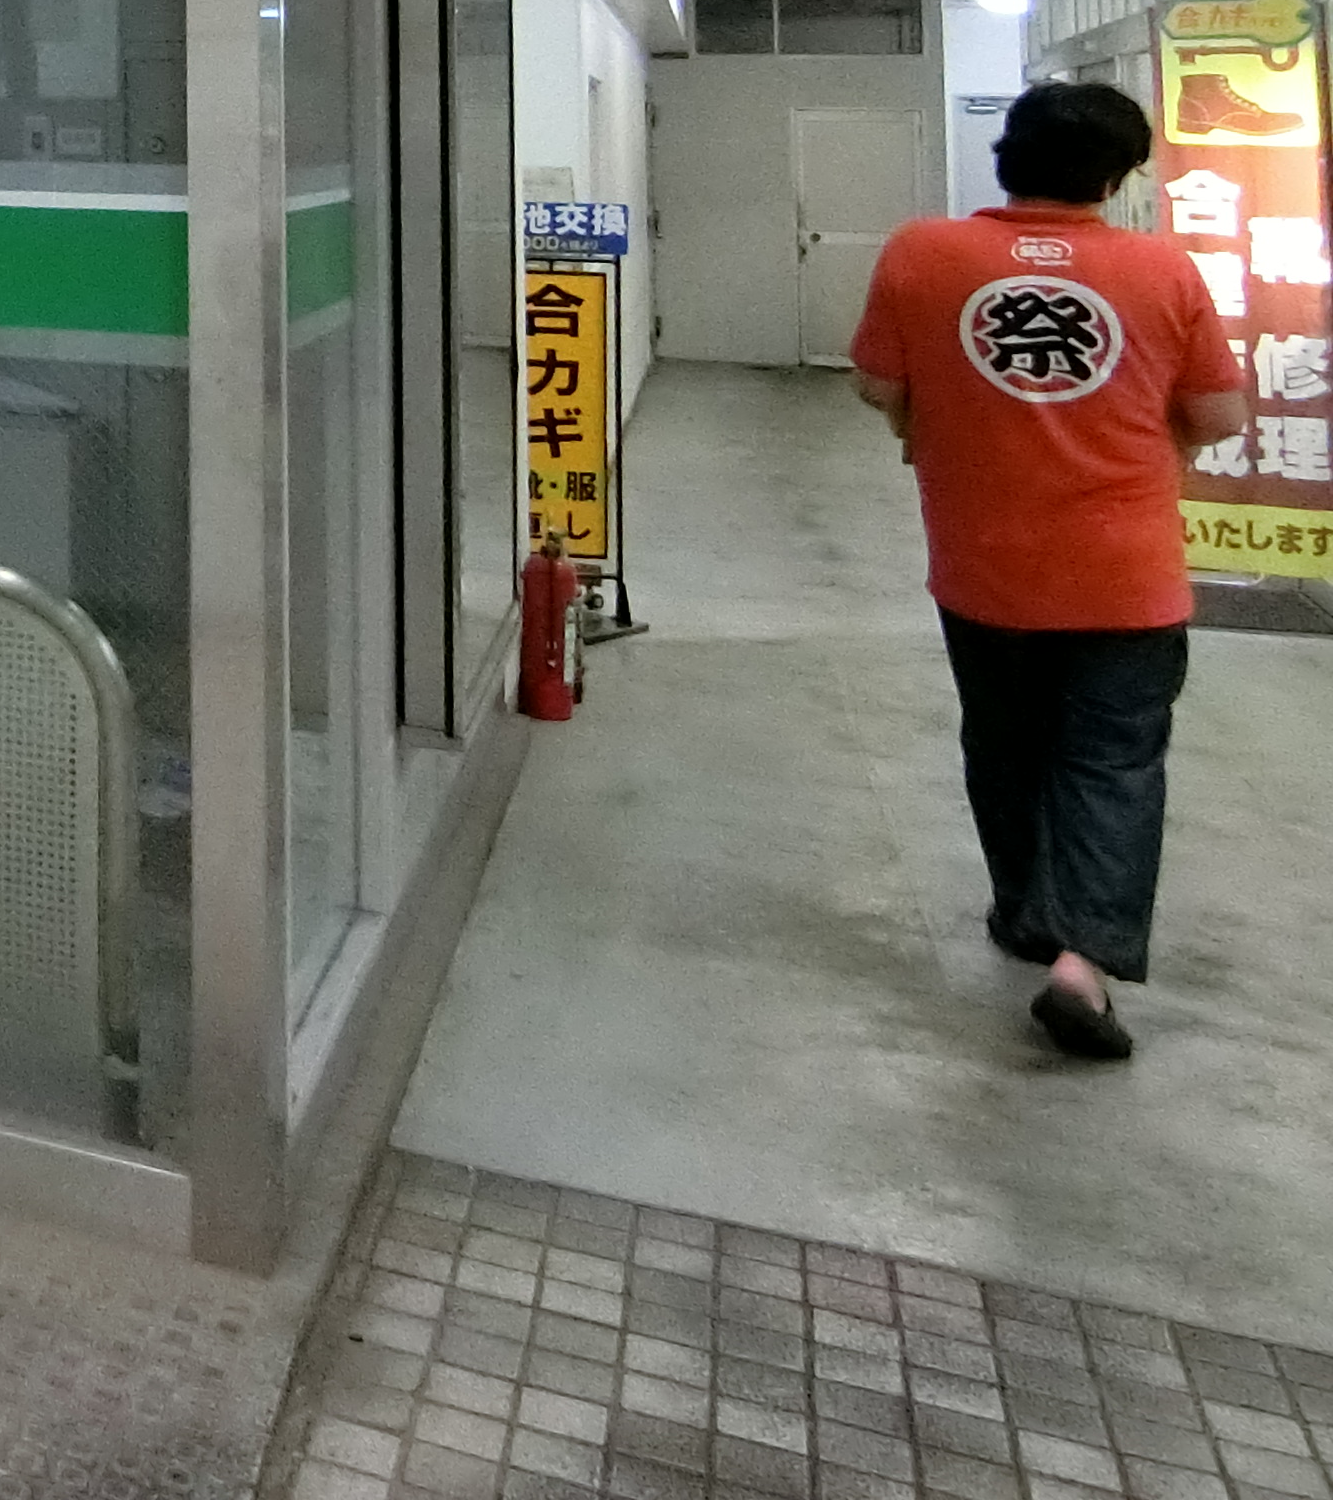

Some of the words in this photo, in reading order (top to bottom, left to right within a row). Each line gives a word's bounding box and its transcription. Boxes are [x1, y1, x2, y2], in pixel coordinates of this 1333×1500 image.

[526, 283, 584, 459] 合カギ
[984, 288, 1102, 382] 祭
